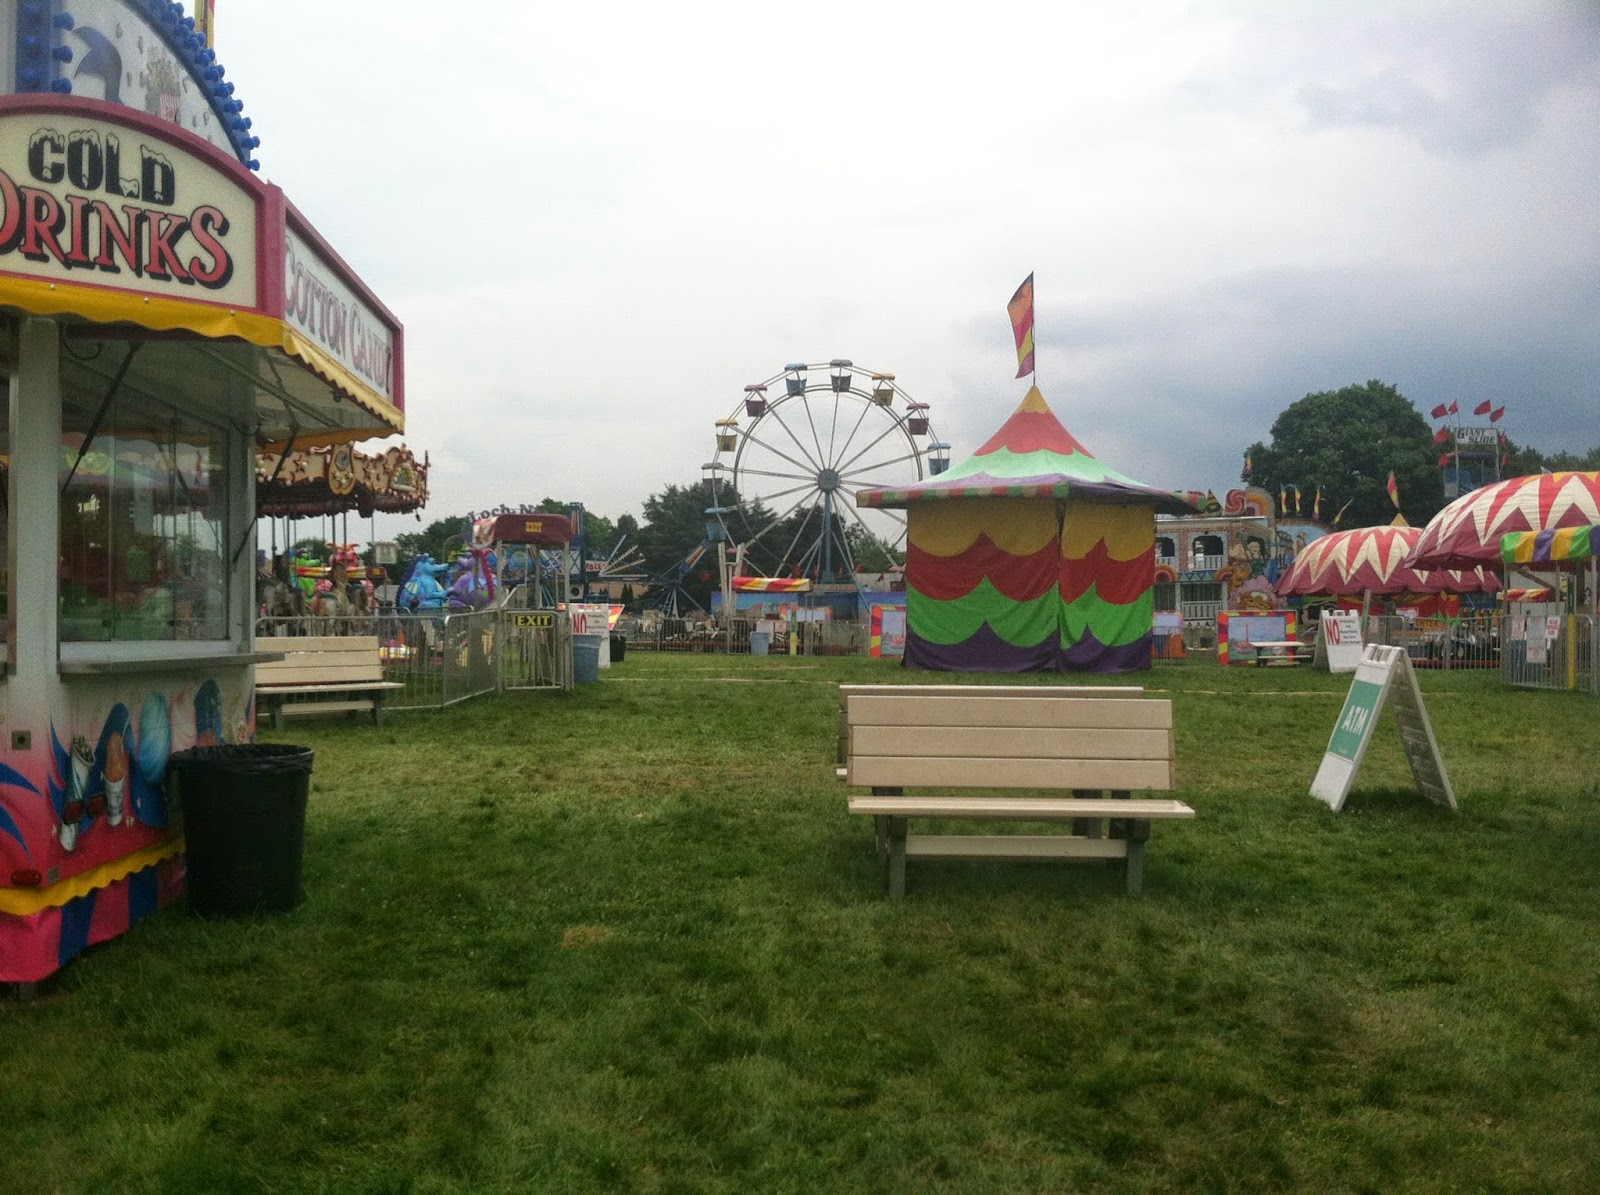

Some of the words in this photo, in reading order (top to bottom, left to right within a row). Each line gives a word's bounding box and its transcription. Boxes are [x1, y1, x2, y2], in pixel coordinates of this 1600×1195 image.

[28, 127, 175, 206] COLD
[285, 235, 347, 360] COTTON
[1457, 429, 1486, 439] GIANT
[1468, 436, 1496, 444] SLIDE
[526, 522, 542, 532] EXIT
[517, 615, 551, 627] EXIT
[573, 613, 587, 634] NO
[1325, 619, 1340, 645] NO
[1341, 705, 1369, 735] ATM
